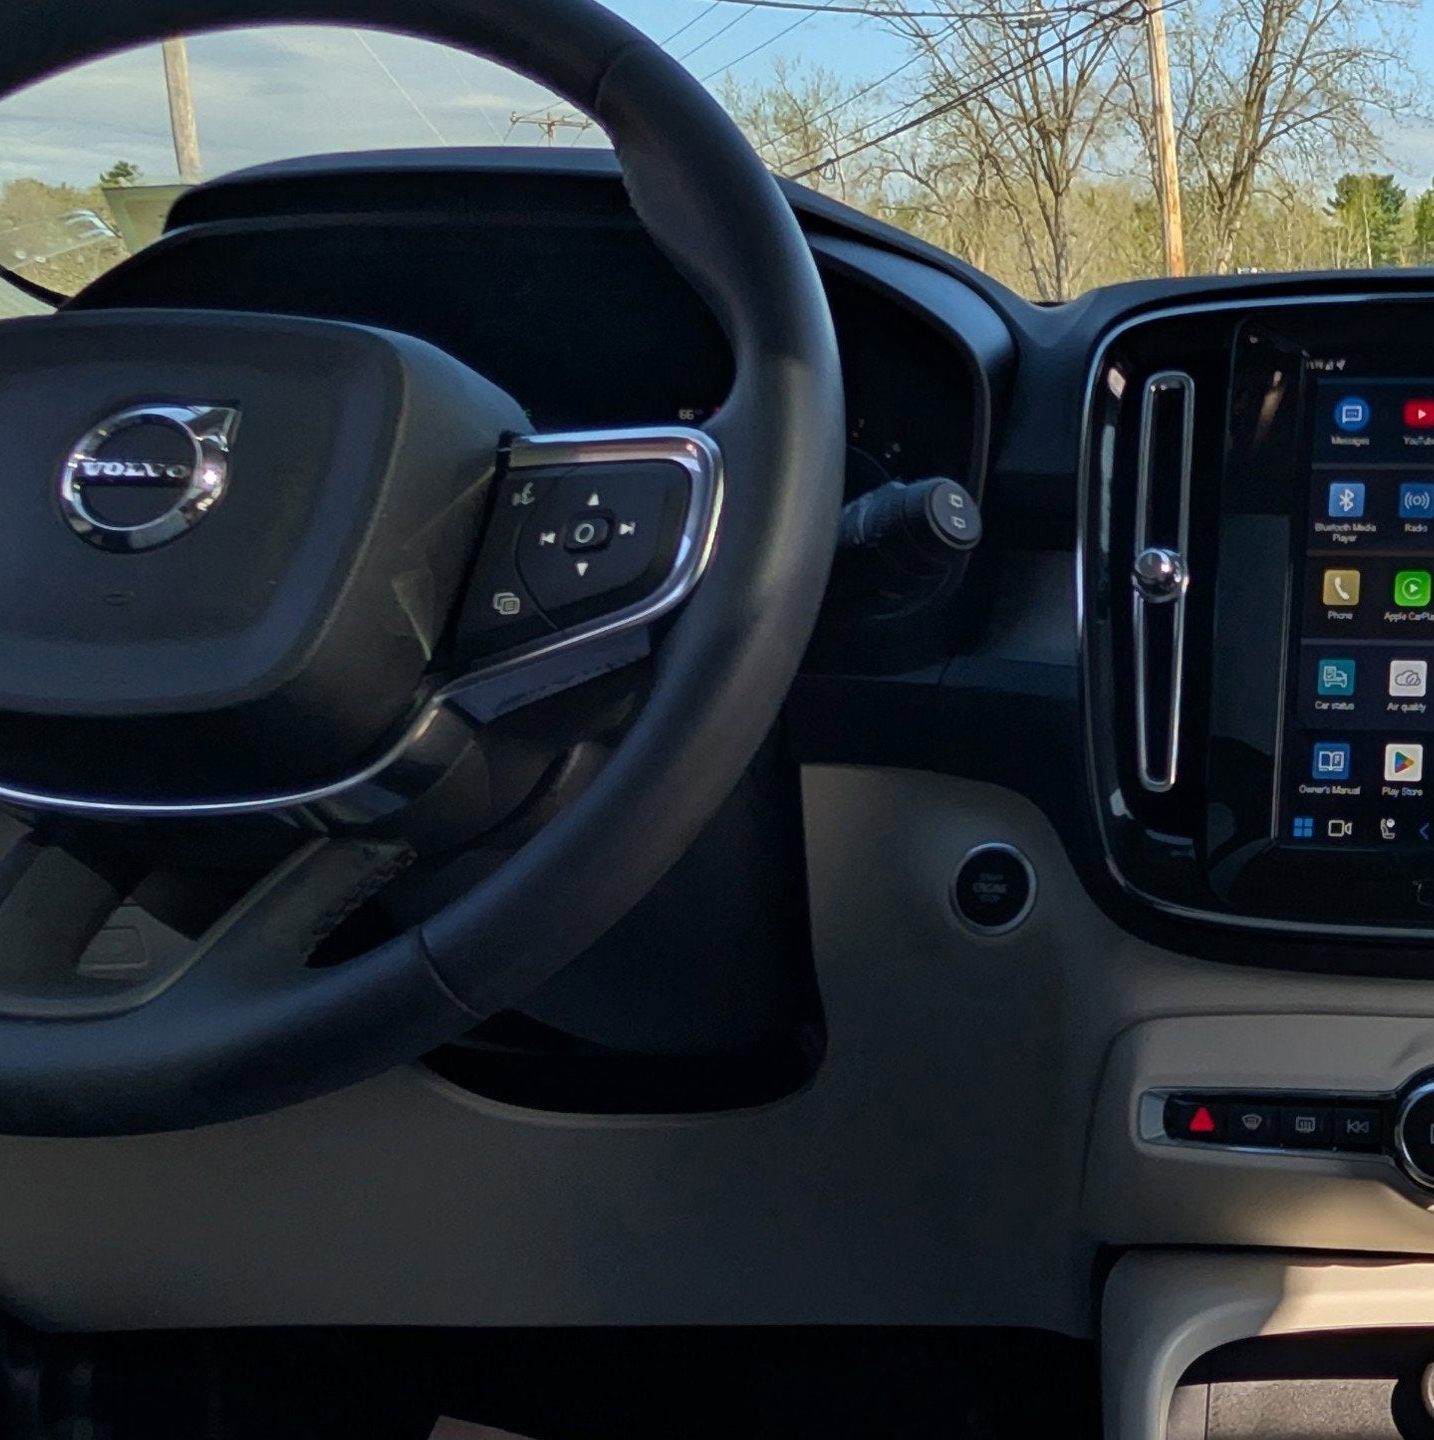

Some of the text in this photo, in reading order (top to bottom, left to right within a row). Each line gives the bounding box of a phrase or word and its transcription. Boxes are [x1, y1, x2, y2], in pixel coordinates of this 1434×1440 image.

[1331, 435, 1370, 448] Messages
[81, 460, 192, 479] VOLVO
[1314, 522, 1377, 534] Bluetooth Media
[1404, 522, 1429, 534] Radio
[1332, 533, 1358, 545] Player
[1327, 610, 1353, 621] Phone
[1384, 611, 1407, 623] Apple
[1314, 700, 1355, 711] Car status
[1386, 701, 1426, 714] Air quality
[1299, 784, 1361, 795] Owner's Manual
[1381, 785, 1424, 799] Play Store
